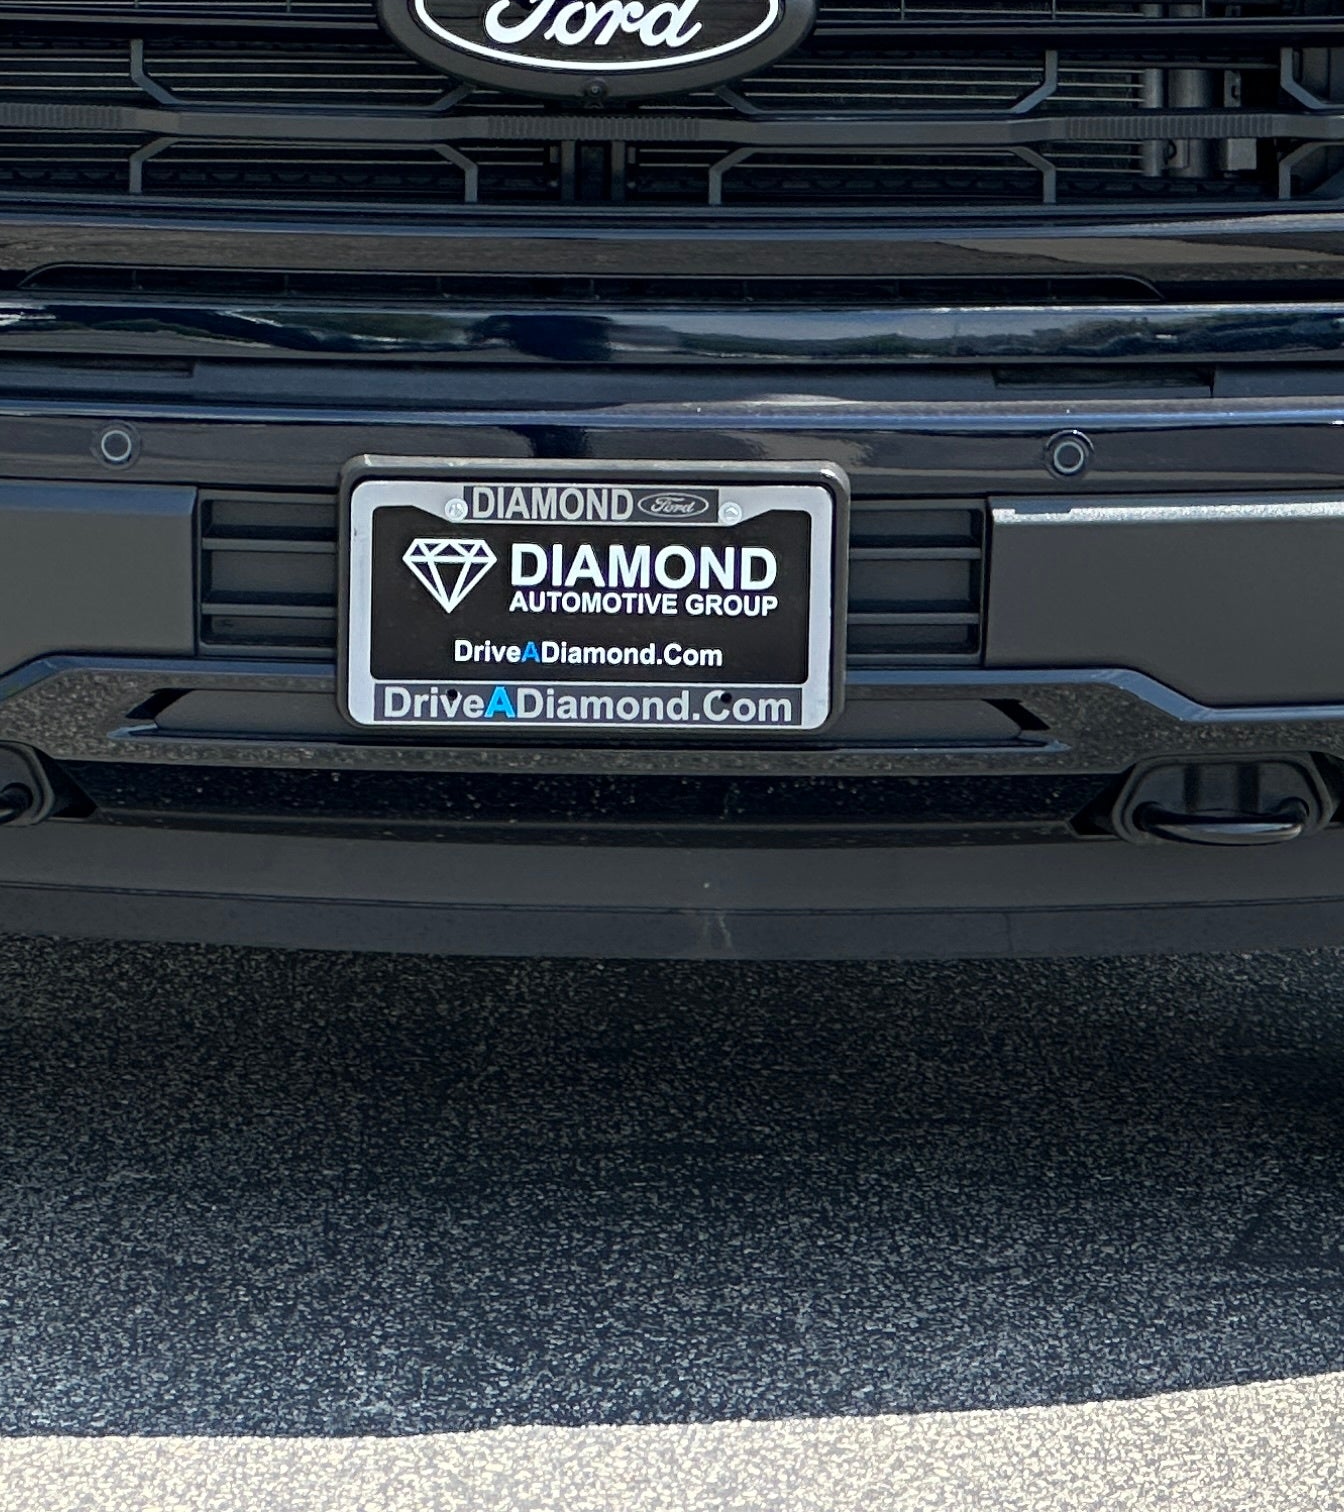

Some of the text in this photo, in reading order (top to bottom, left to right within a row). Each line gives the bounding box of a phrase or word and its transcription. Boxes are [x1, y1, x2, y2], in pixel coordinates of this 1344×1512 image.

[472, 486, 695, 520] DIAMOND Ford
[510, 543, 778, 590] DIAMOND
[509, 591, 779, 617] AUTOMOTIVE GROUP
[454, 640, 723, 667] DriveADiamond.Com
[383, 686, 792, 723] DriveADiamond.Com
